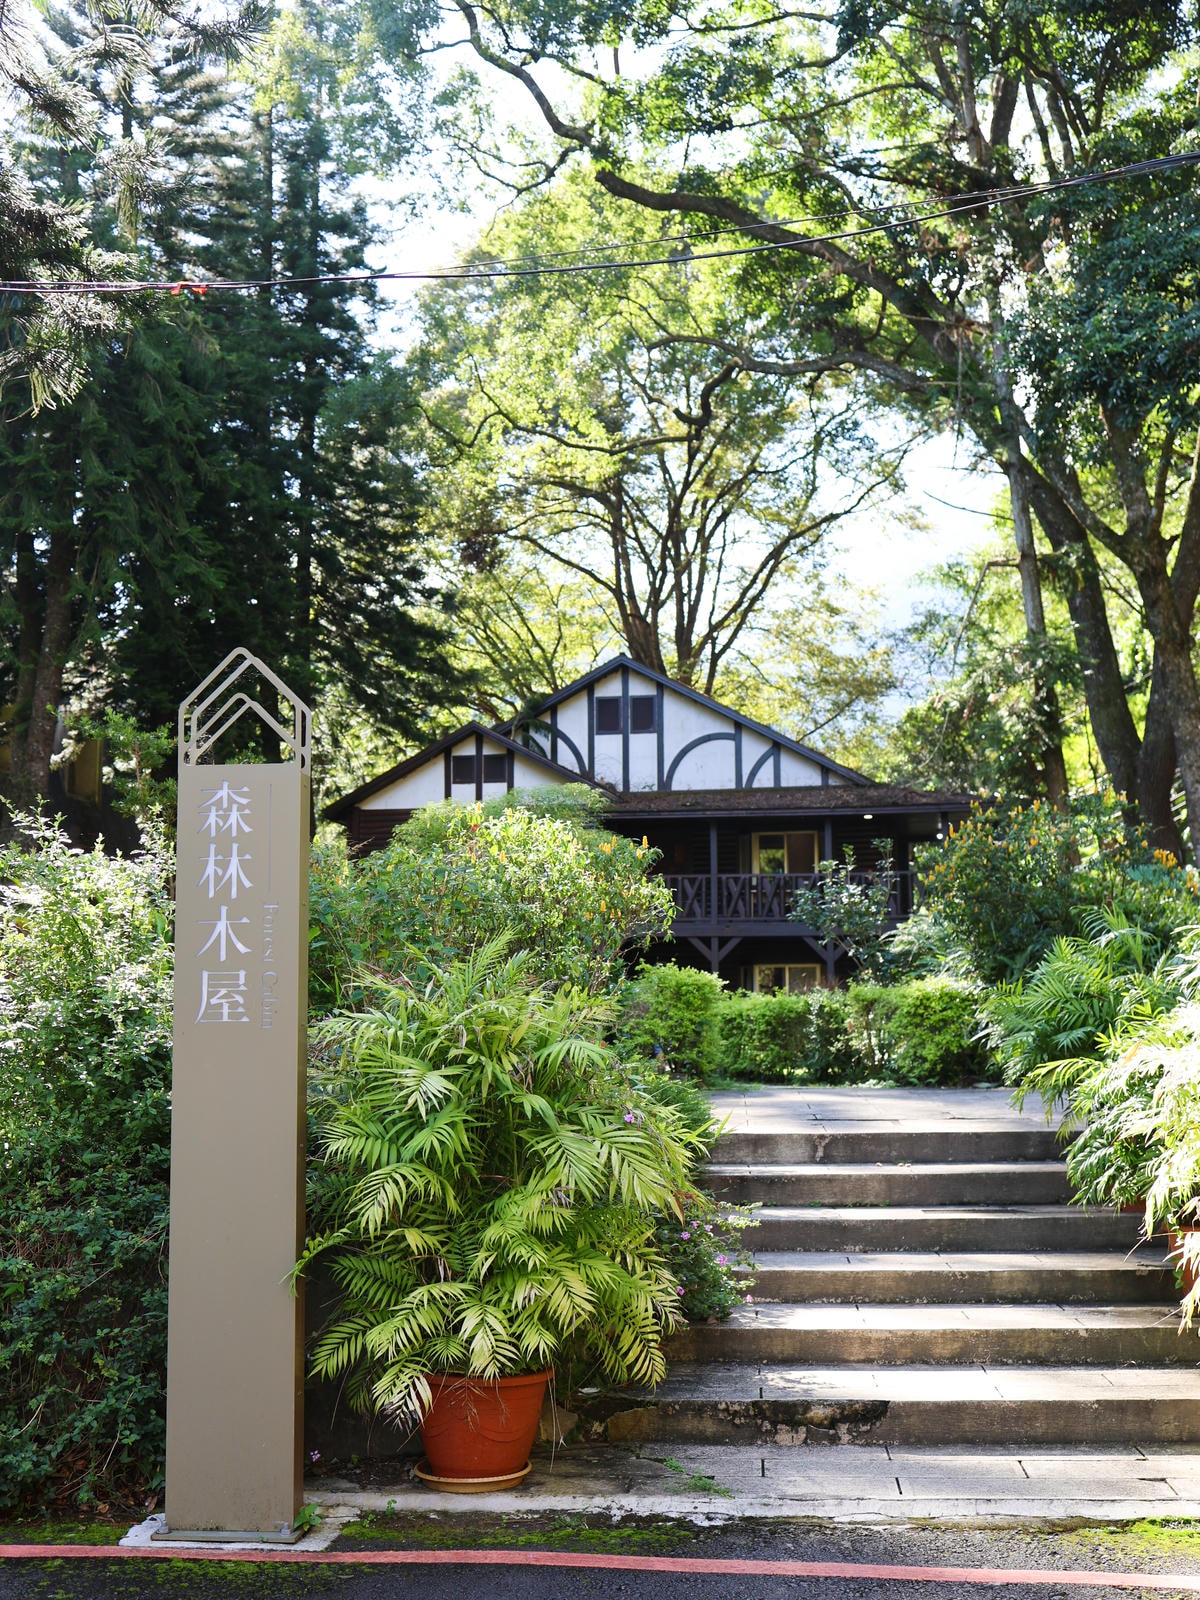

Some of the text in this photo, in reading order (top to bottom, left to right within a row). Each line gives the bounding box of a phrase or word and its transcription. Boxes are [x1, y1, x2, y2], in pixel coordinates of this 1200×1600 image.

[194, 780, 254, 1025] 森林木屋
[260, 901, 280, 1030] Forest Cabin
